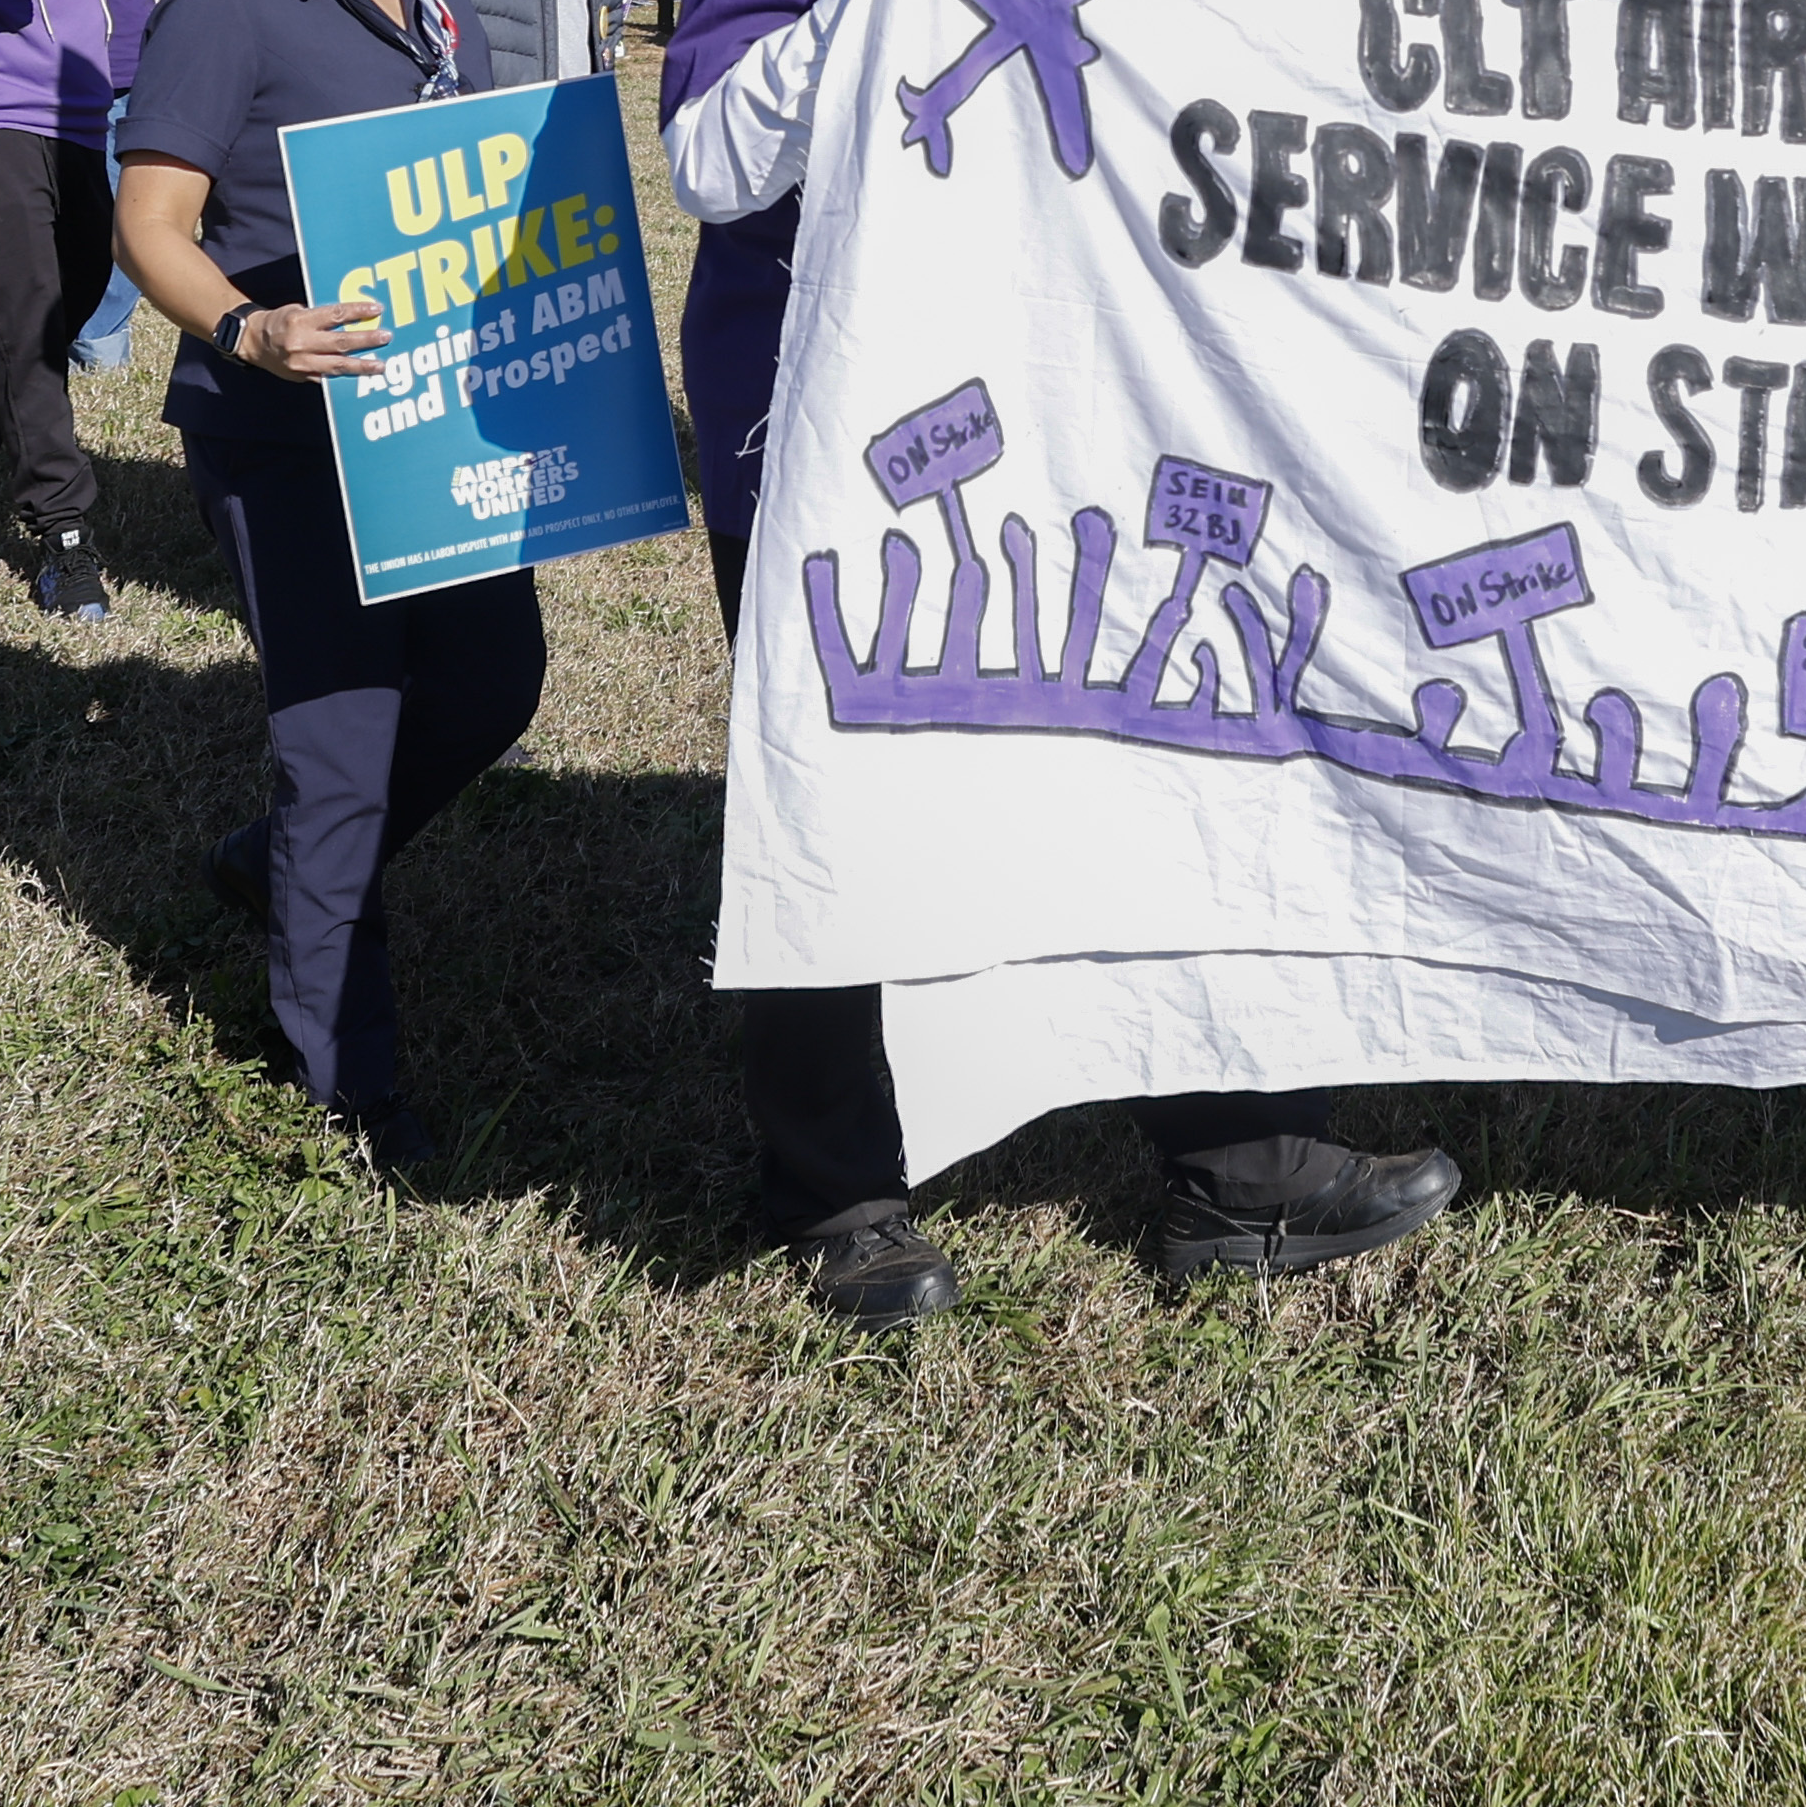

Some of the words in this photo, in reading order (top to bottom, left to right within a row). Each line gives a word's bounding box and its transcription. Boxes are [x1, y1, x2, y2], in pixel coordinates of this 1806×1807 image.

[385, 133, 527, 236] ULP
[1158, 98, 1675, 316] SERVICE
[339, 193, 619, 332] STRIKE:
[357, 308, 516, 398] Against
[532, 267, 626, 335] ABM
[363, 373, 445, 442] and
[456, 313, 631, 408] Prospect
[1417, 326, 1602, 494] ON
[451, 461, 579, 506] WORKERS
[458, 445, 568, 487] AIRPORT
[887, 434, 931, 485] ON
[930, 412, 994, 459] Strike
[471, 484, 566, 520] UNITED
[1165, 471, 1248, 508] SEIU
[364, 562, 380, 575] THE
[380, 556, 406, 572] UNION
[407, 552, 423, 568] HAS
[424, 550, 431, 562] A
[431, 545, 456, 561] LABOR
[457, 537, 489, 555] DISPUTE
[488, 532, 509, 547] WITH
[528, 525, 544, 539] AND
[545, 516, 581, 535] PROSPECT
[582, 513, 603, 528] ONLY,
[604, 509, 615, 521] NO
[616, 503, 640, 518] OTHER
[641, 495, 681, 513] EMPLOYER.
[1479, 561, 1575, 608] Strike
